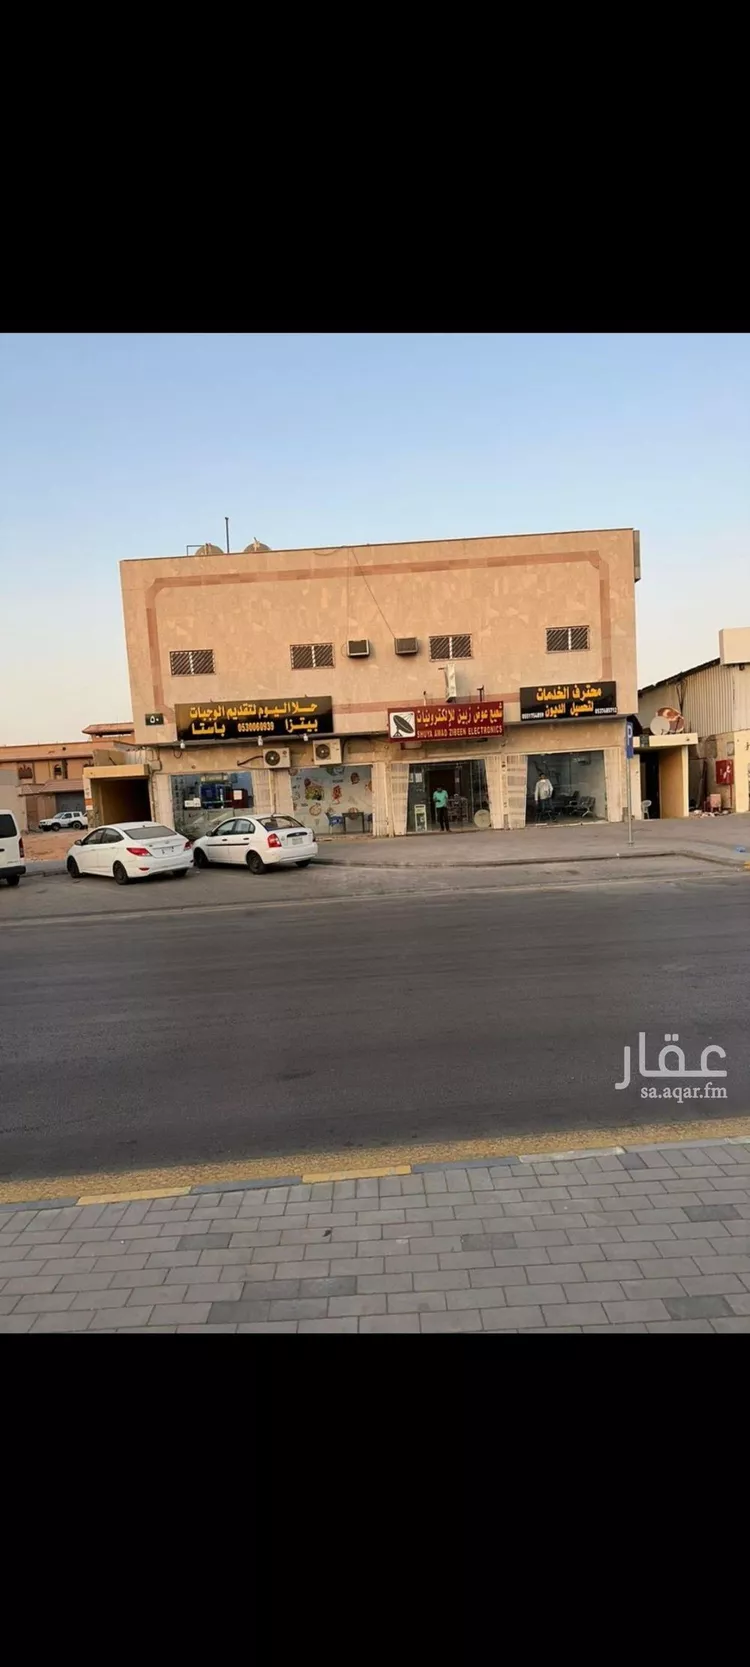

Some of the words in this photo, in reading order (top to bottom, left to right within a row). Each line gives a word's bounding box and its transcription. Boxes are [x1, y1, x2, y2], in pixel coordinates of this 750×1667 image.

[536, 686, 569, 701] الخدمات
[572, 684, 602, 701] محترف
[189, 705, 225, 721] الوجبات
[226, 702, 257, 720] لتقديم
[258, 702, 291, 719] اليوم
[545, 702, 566, 718] الديون
[570, 700, 594, 716] لتحصيل
[149, 715, 160, 724] ٥٠
[285, 717, 318, 733] بيتزا
[191, 721, 226, 737] باستا
[468, 725, 503, 736] ELECTRONICS
[627, 725, 633, 745] P
